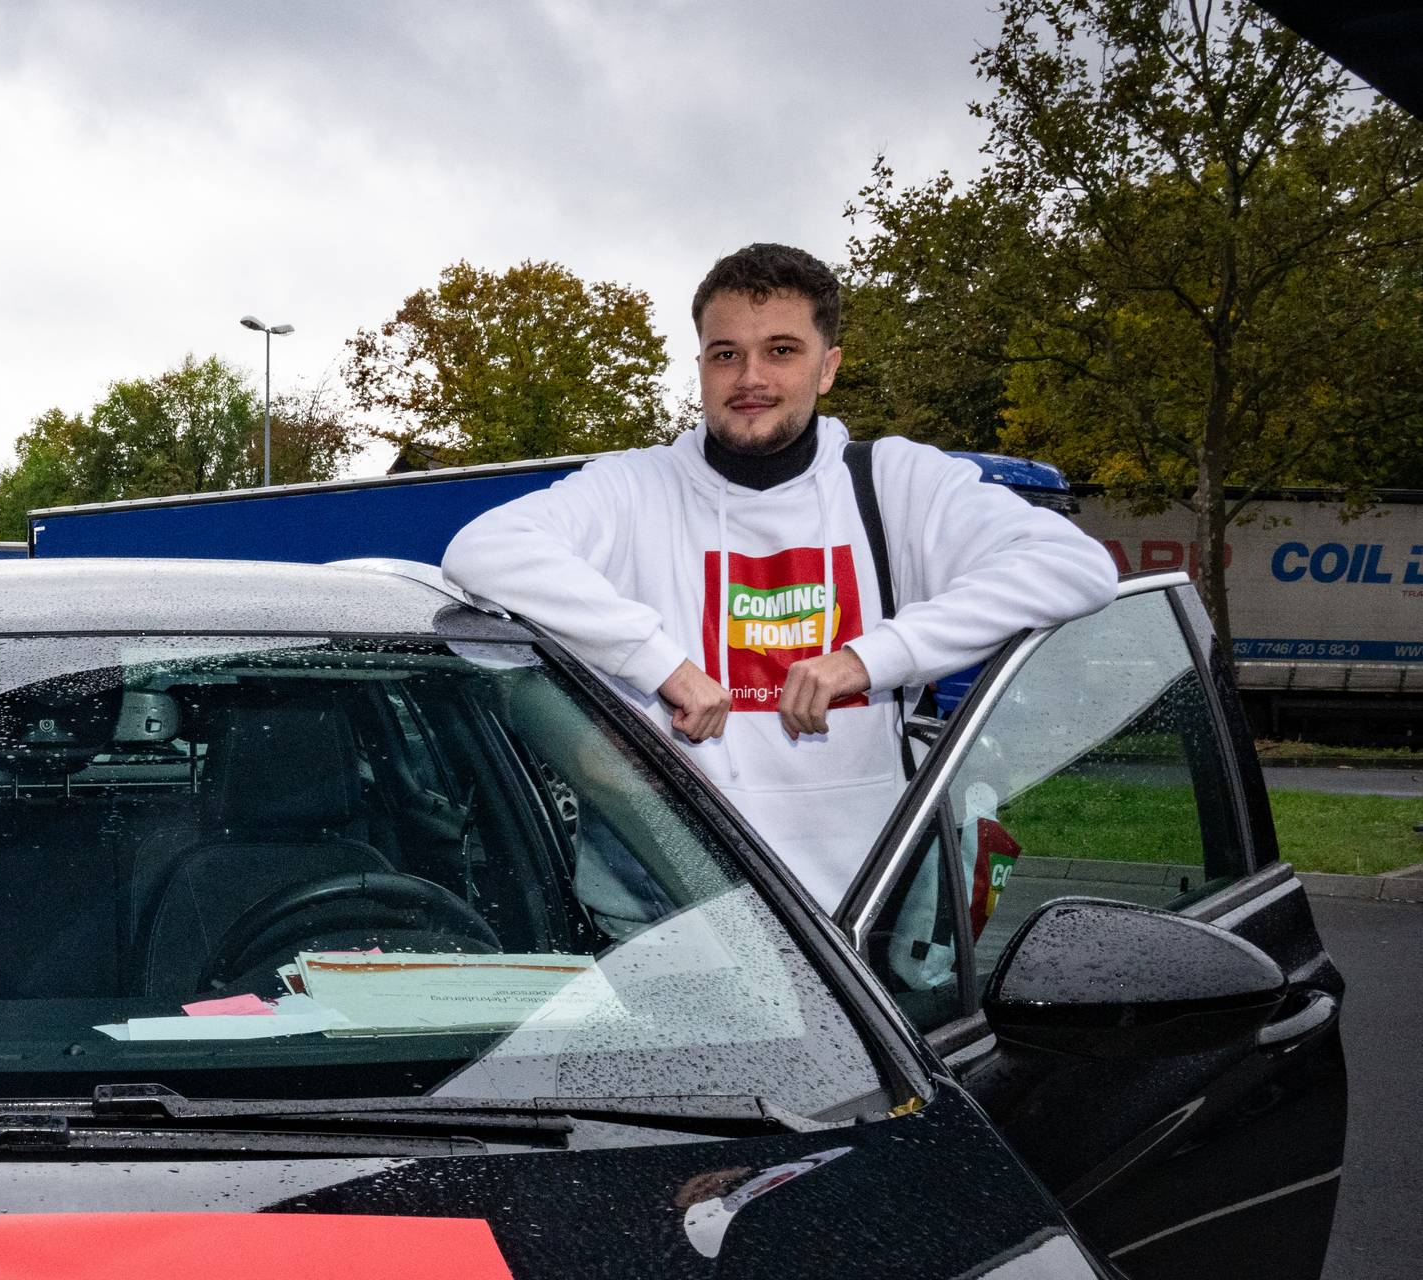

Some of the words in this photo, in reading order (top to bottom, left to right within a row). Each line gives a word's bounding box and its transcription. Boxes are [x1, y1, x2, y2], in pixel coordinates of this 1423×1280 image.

[1271, 541, 1393, 584] COIL
[733, 585, 826, 617] COMING
[745, 620, 817, 646] HOME
[1297, 643, 1315, 656] 20
[1328, 644, 1360, 657] 82-0
[730, 685, 784, 702] ming-h
